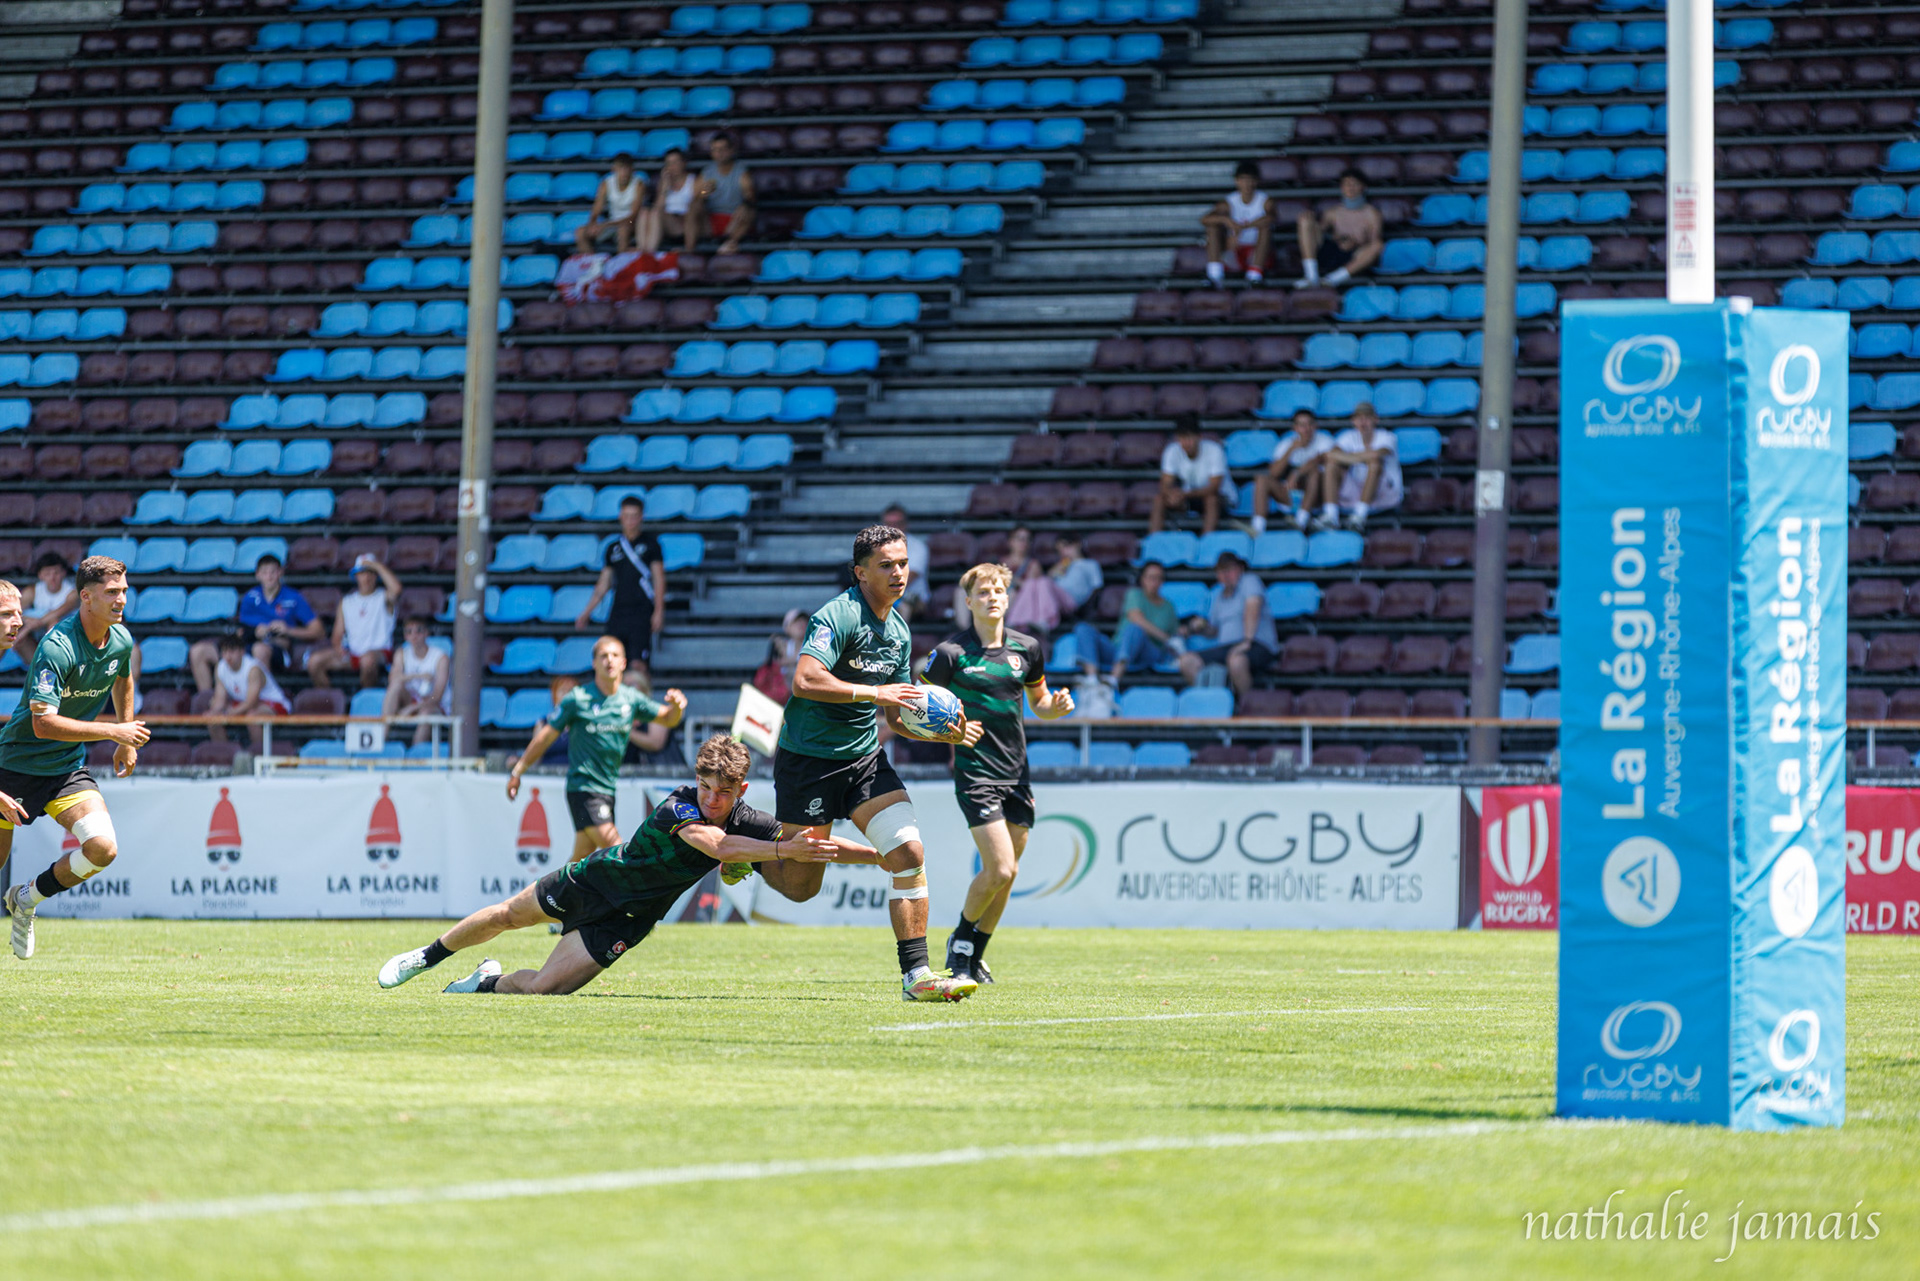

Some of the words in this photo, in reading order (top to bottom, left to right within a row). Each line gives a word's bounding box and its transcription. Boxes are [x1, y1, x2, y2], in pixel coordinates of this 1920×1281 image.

[1600, 507, 1656, 731] Région
[1769, 517, 1808, 743] Région
[360, 731, 373, 749] D
[1602, 748, 1646, 819] La
[1770, 758, 1802, 833] La
[171, 877, 194, 895] LA
[201, 875, 278, 895] PLAGNE
[327, 876, 351, 894] LA
[360, 874, 439, 893] PLAGNE
[480, 875, 503, 895] LA
[1117, 872, 1241, 901] AUVERGNE
[1249, 867, 1328, 901] RHÔNE
[1351, 872, 1423, 901] ALPES
[1493, 890, 1543, 904] WORLD
[1484, 902, 1552, 923] RUGBY
